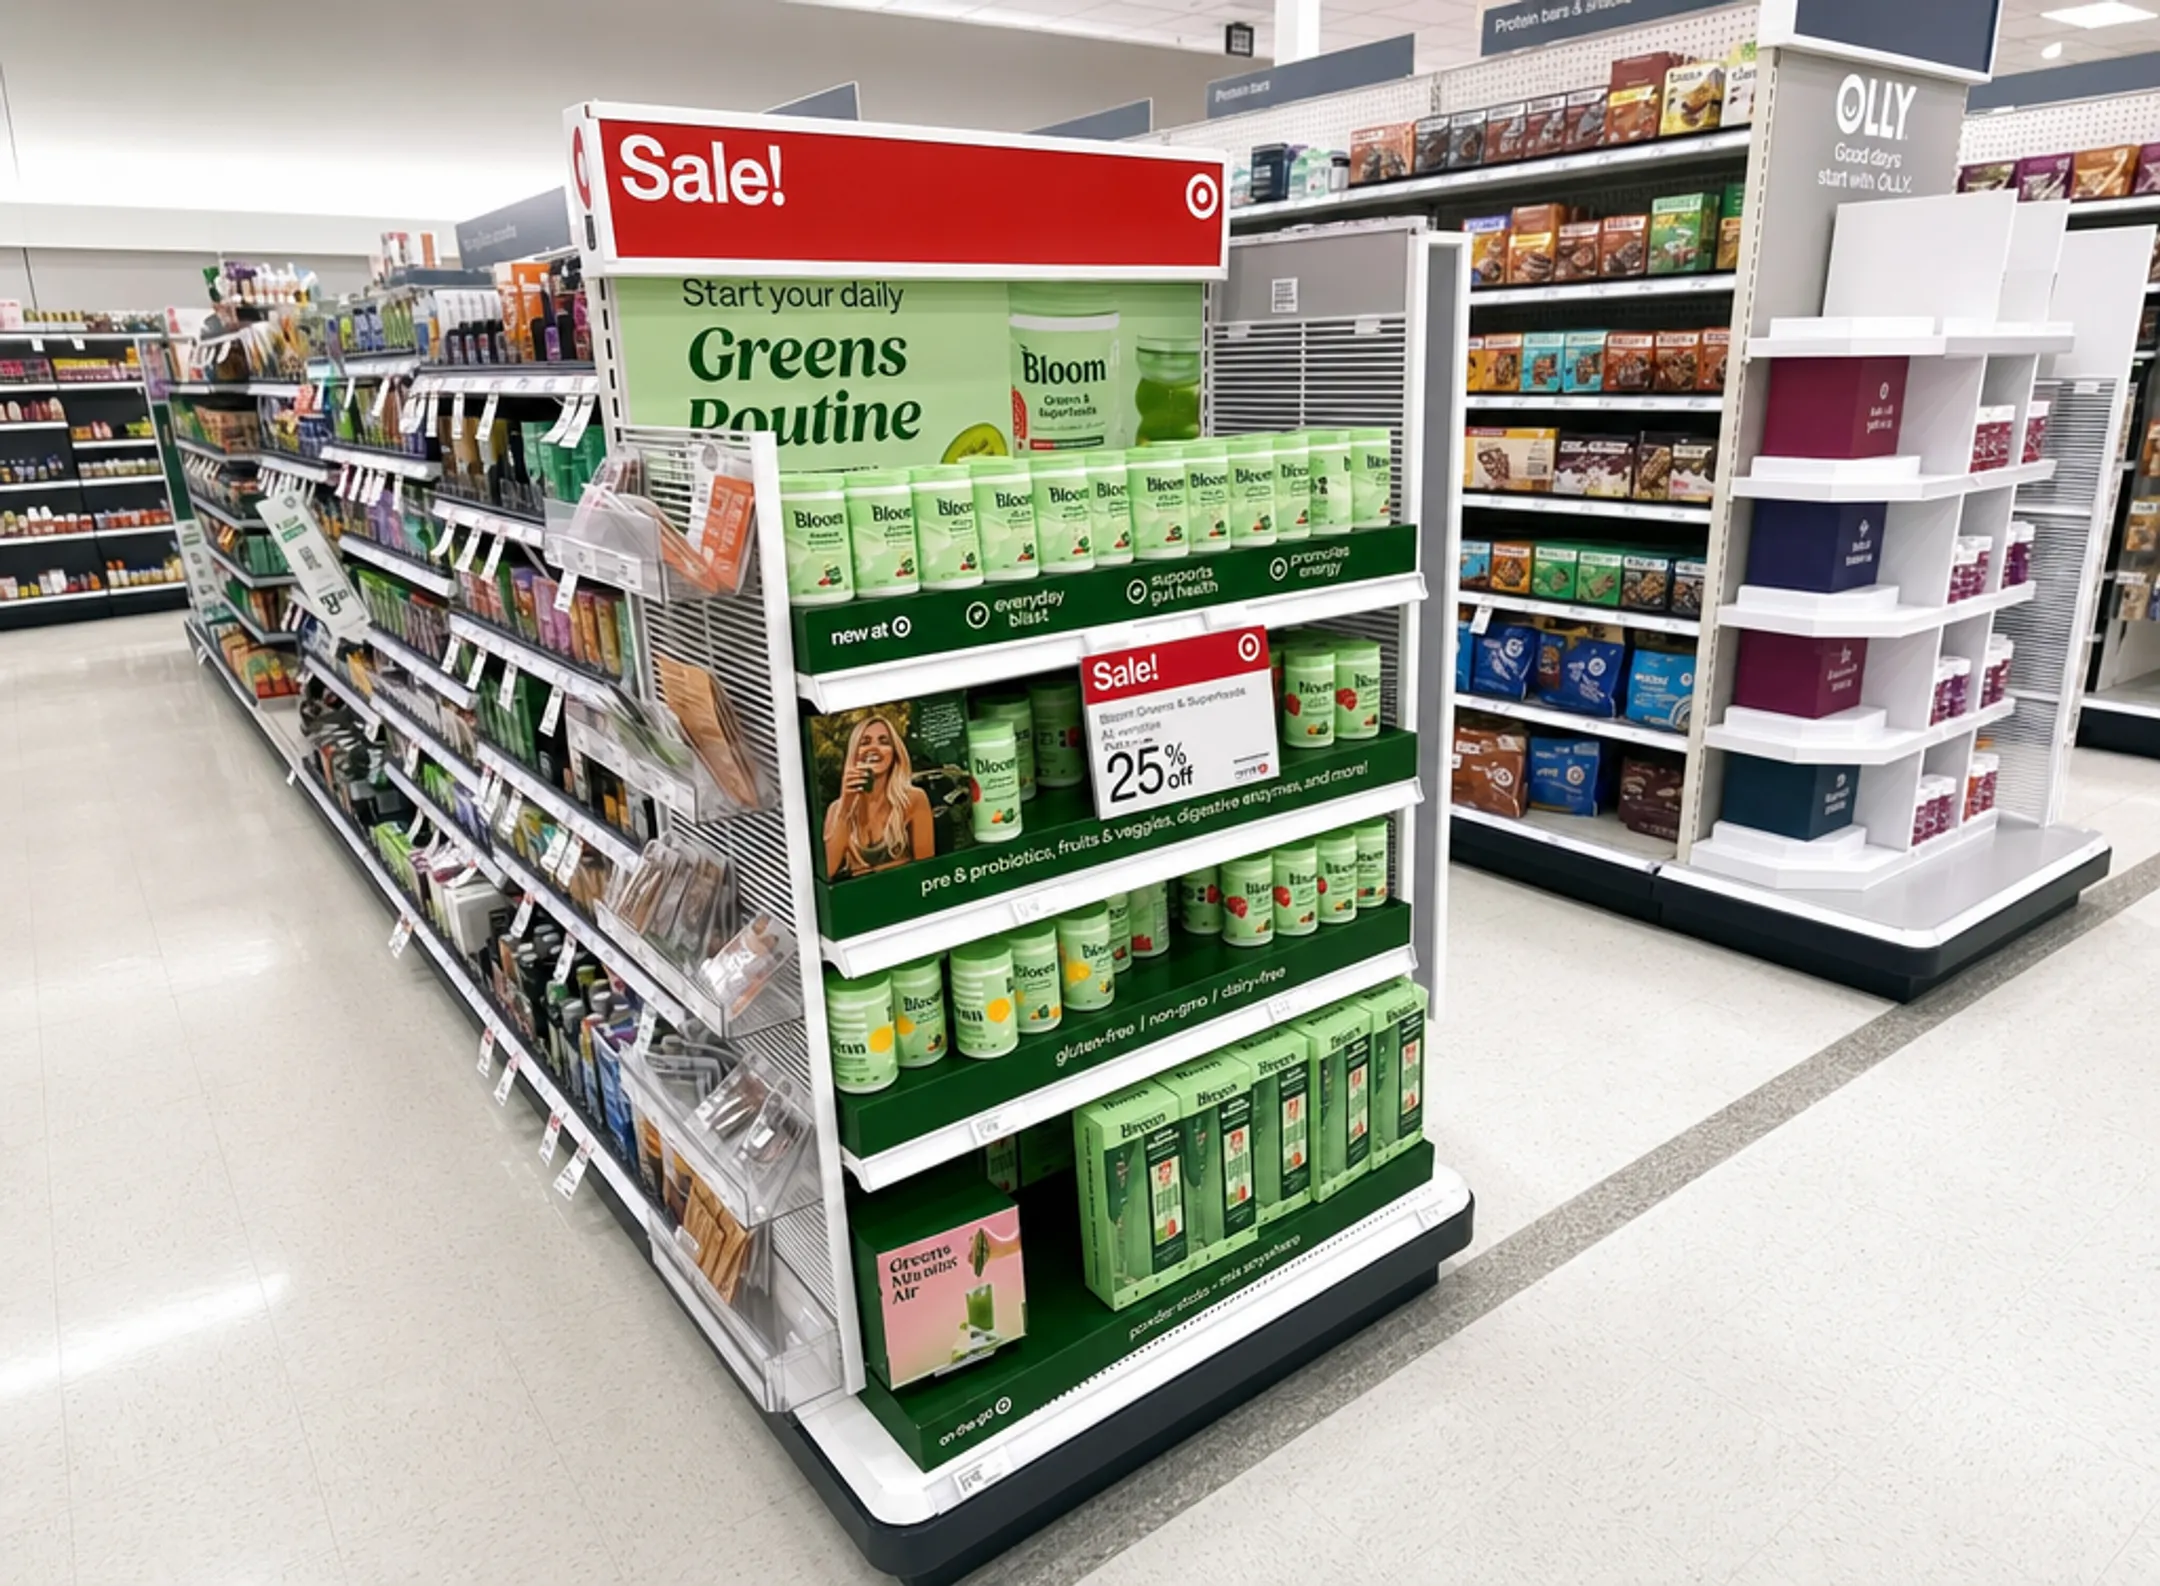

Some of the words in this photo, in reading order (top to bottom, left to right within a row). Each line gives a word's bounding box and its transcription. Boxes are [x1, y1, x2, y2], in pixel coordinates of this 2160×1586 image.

[1495, 13, 1539, 33] Protein
[1541, 7, 1569, 23] bars
[1836, 73, 1917, 141] OLLY
[1835, 142, 1870, 164] Good
[1870, 151, 1902, 169] days
[620, 134, 786, 207] Sale!
[1818, 168, 1847, 188] start
[683, 278, 764, 307] Start
[769, 285, 834, 314] your
[840, 281, 904, 315] daily
[689, 326, 907, 382] Greens
[1021, 346, 1106, 385] Bloom
[1151, 566, 1214, 587] supports
[1299, 561, 1343, 578] energy
[994, 589, 1065, 613] everyday
[1151, 587, 1175, 607] gut
[1177, 580, 1218, 598] health
[831, 625, 869, 645] new
[871, 622, 888, 639] at
[1093, 653, 1159, 691] Sale!
[1177, 698, 1186, 708] &
[1165, 741, 1187, 767] %
[1107, 746, 1164, 803] 25
[1167, 765, 1193, 789] off
[921, 873, 950, 896] pre
[954, 868, 967, 884] &
[970, 845, 1056, 884] probiotics,
[1058, 833, 1100, 854] fruits
[1102, 829, 1113, 843] &
[1177, 797, 1239, 824] digestive
[1304, 770, 1330, 789] and
[1331, 760, 1369, 780] more!
[1056, 1023, 1135, 1066] gluten-free
[1149, 996, 1208, 1026] non-gmo
[1222, 967, 1286, 999] dairy-free
